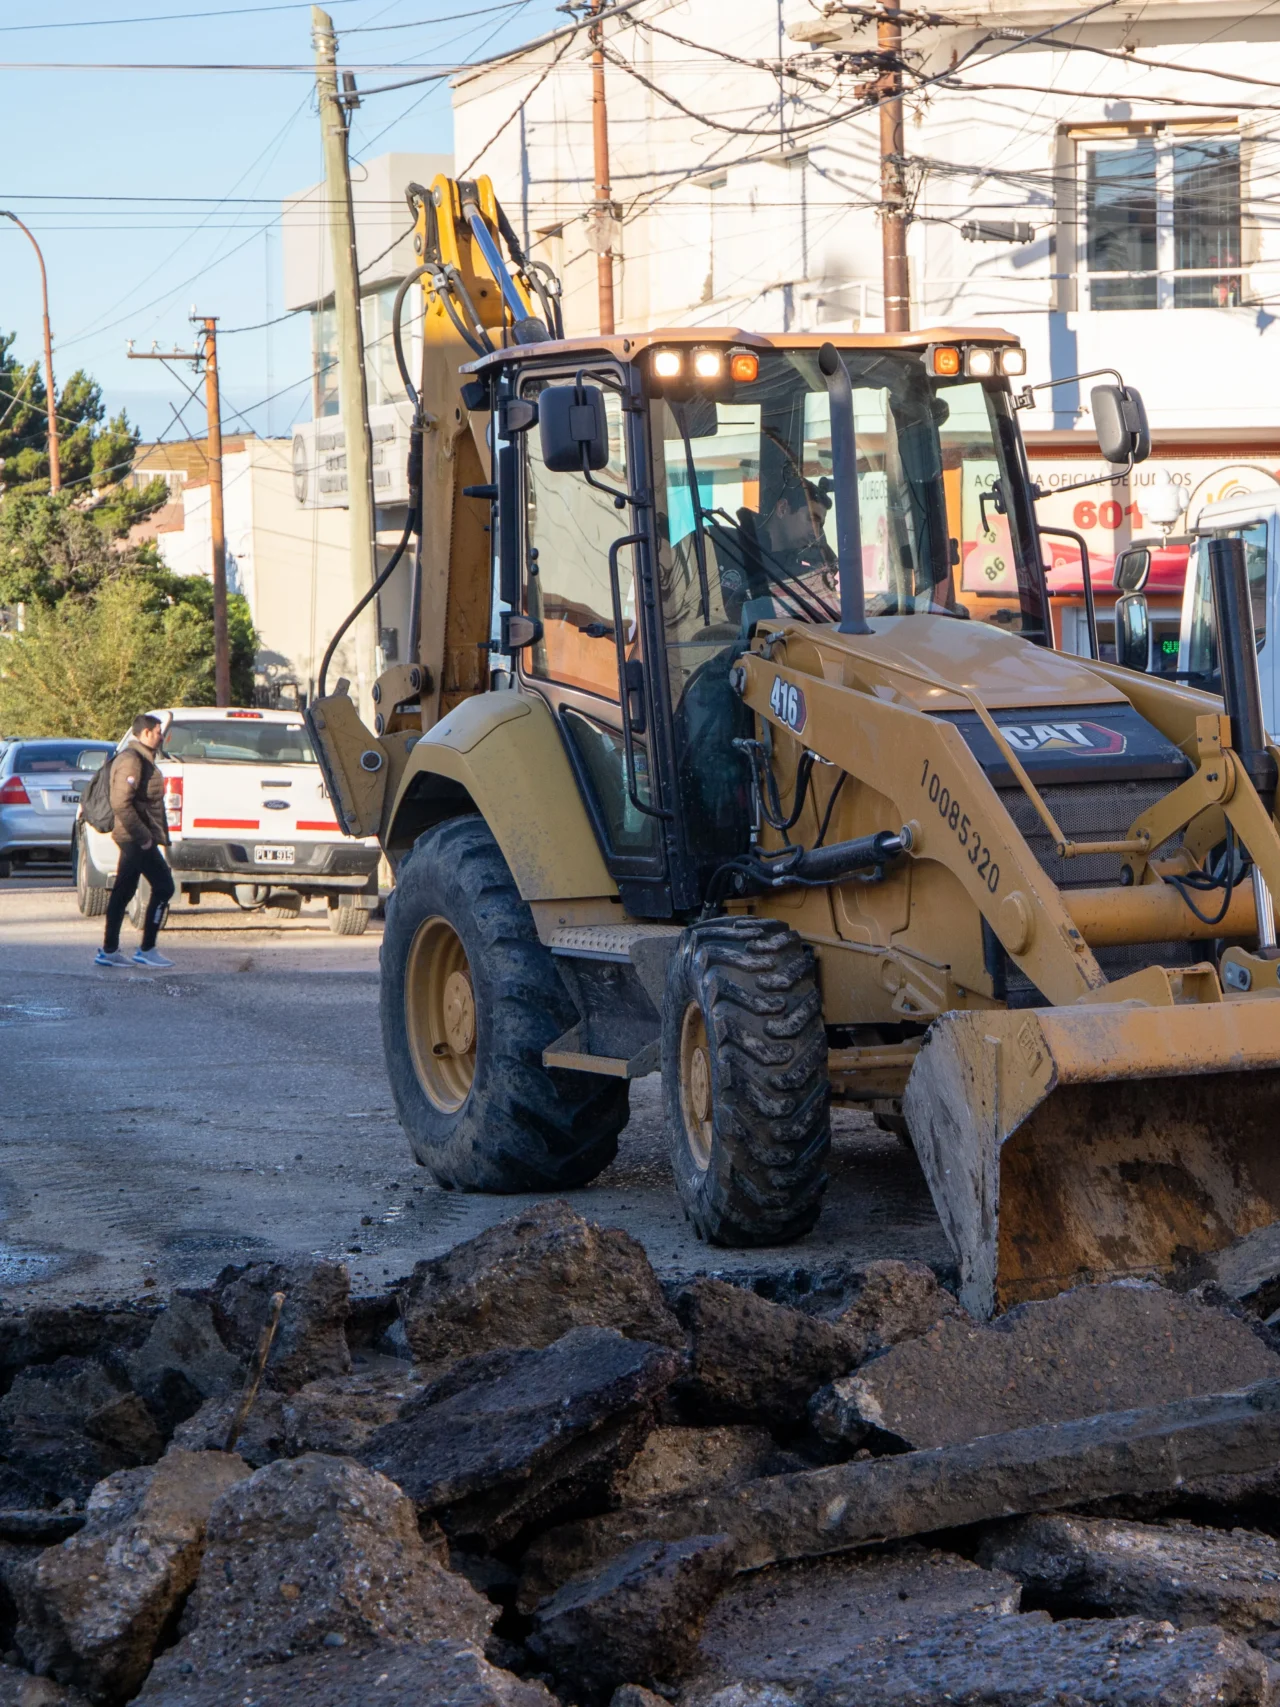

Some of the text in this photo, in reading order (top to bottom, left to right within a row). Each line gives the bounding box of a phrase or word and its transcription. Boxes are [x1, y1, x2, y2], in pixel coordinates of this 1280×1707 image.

[770, 676, 798, 726] 416
[998, 723, 1095, 750] CAT
[920, 759, 1000, 893] 10085320
